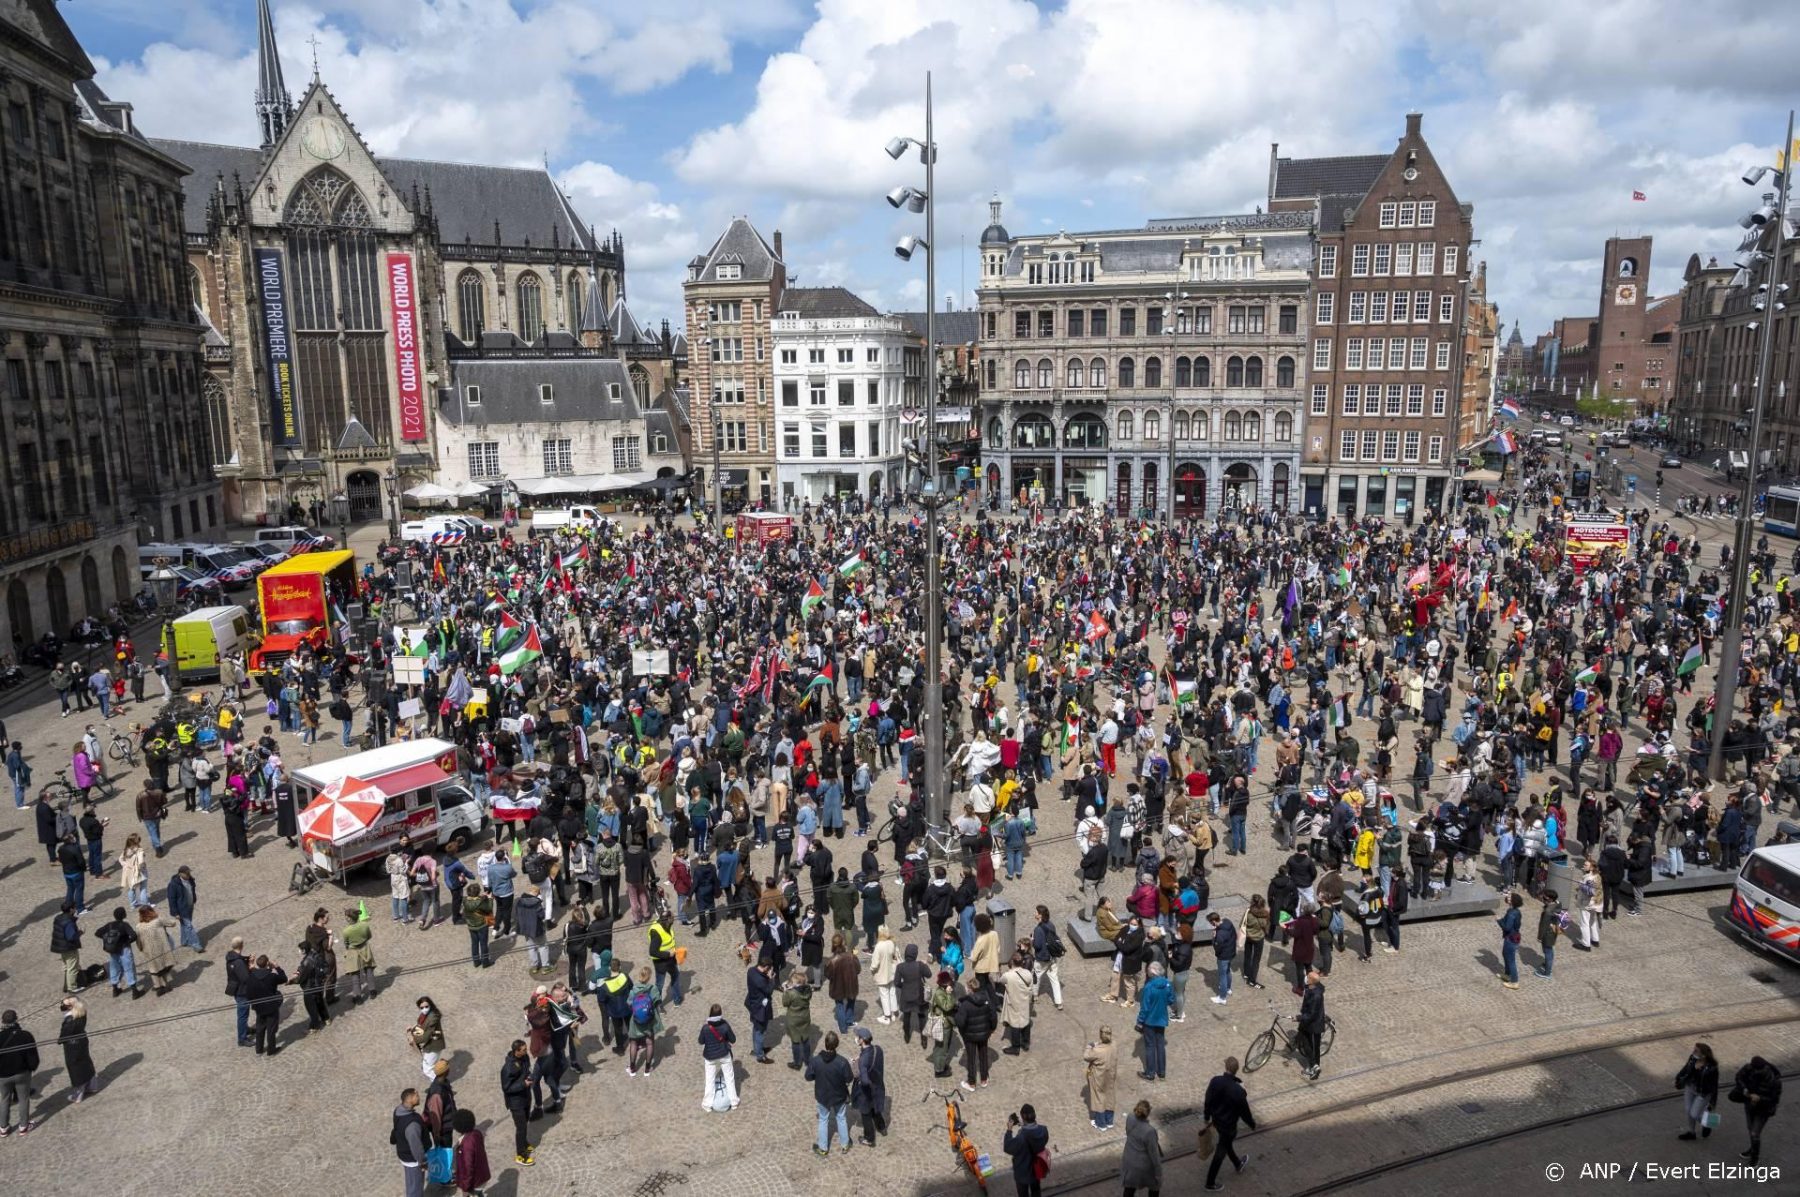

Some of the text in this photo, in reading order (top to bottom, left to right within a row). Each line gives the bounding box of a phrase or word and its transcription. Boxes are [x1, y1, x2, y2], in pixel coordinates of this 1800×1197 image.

[261, 257, 287, 359] WORLD PREMIERE
[392, 263, 421, 433] WORLD PRESS PHOTO 2021
[280, 363, 295, 438] BOOK TICKETS ONLINE
